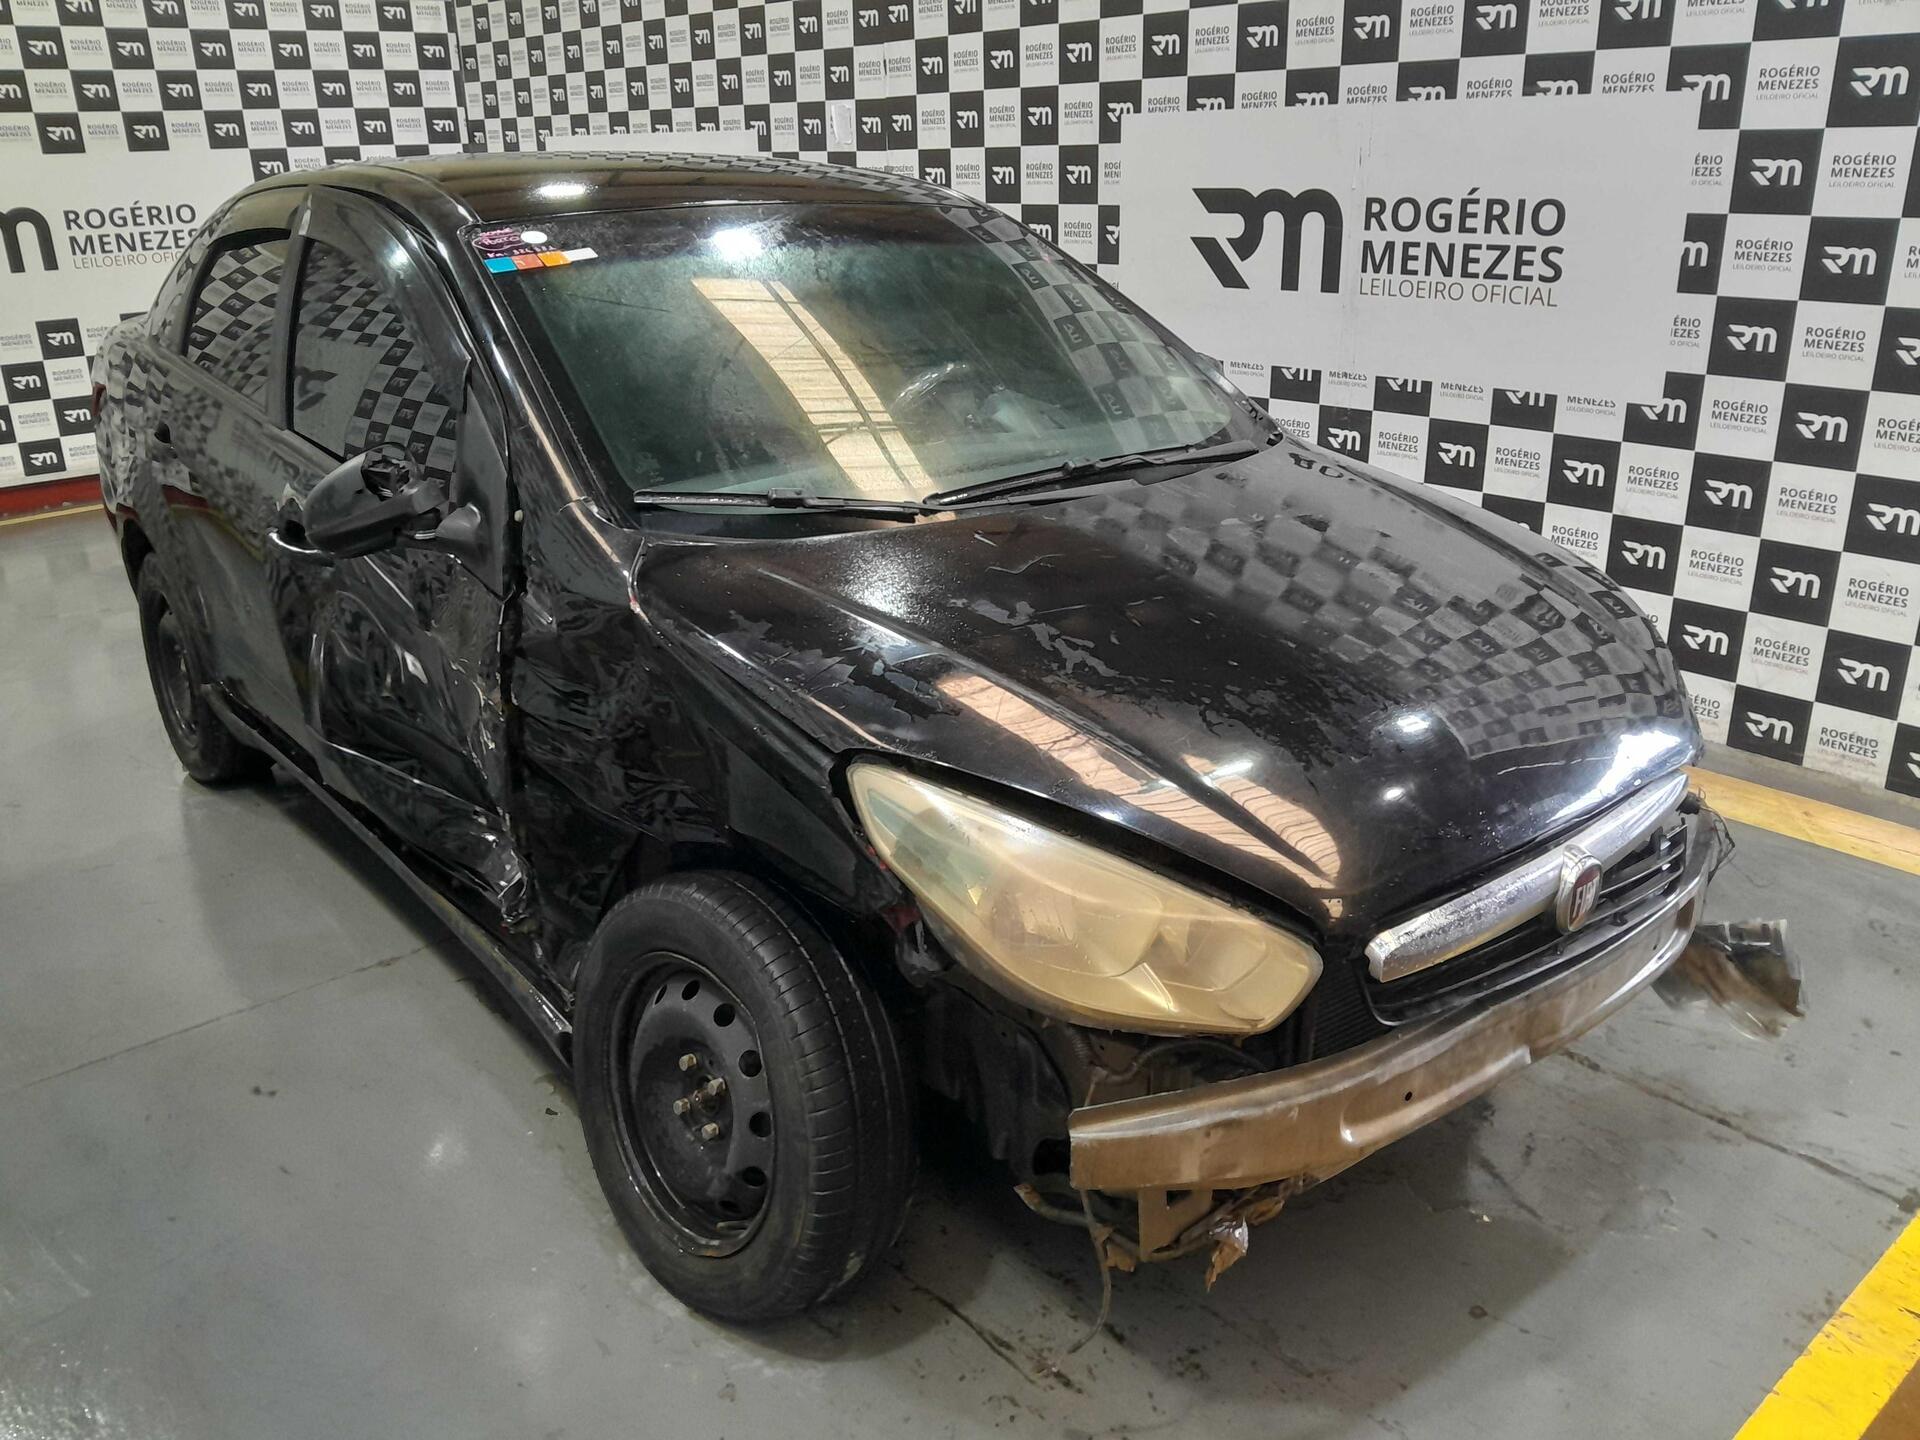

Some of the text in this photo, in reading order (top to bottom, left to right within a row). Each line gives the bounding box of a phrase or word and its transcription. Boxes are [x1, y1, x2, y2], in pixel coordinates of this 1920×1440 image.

[1410, 4, 1454, 17] ROGÉRIO
[1539, 5, 1589, 18] MENEZES
[1296, 15, 1335, 28] ROGÉRIO
[1409, 15, 1454, 28] MENEZES
[1195, 25, 1230, 37] ROGÉRIO
[1296, 26, 1334, 38] MENEZES
[1105, 34, 1136, 45] ROGÉRIO
[1195, 35, 1230, 46] MENEZES
[1025, 42, 1053, 52] ROGÉRIO
[1105, 44, 1136, 54] MENEZES
[953, 49, 978, 59] ROGÉRIO
[1025, 51, 1053, 61] MENEZES
[953, 58, 979, 67] MENEZES
[1603, 71, 1655, 84] ROGÉRIO
[1759, 64, 1820, 78] ROGÉRIO
[1347, 83, 1388, 96] ROGÉRIO
[1467, 77, 1513, 90] ROGÉRIO
[1757, 78, 1819, 91] MENEZES
[1241, 90, 1277, 101] ROGÉRIO
[989, 104, 1015, 114] ROGÉRIO
[1064, 100, 1093, 110] ROGÉRIO
[921, 108, 945, 117] ROGÉRIO
[989, 114, 1015, 122] MENEZES
[1064, 110, 1093, 119] MENEZES
[921, 117, 946, 125] MENEZES
[1694, 152, 1723, 165] ÉRIO
[1832, 152, 1897, 165] ROGÉRIO
[955, 162, 980, 171] ROGÉRIO
[1026, 161, 1053, 171] ROGÉRIO
[1830, 167, 1895, 178] MENEZES
[1026, 171, 1053, 179] MENEZES
[63, 200, 196, 230] ROGÉRIO
[1363, 188, 1566, 236] ROGÉRIO
[1064, 220, 1092, 230] ROGÉRIO
[1064, 230, 1092, 238] MENEZES
[1735, 238, 1793, 251] ROGÉRIO
[73, 252, 147, 270] LEILOEIRO
[1361, 240, 1564, 283] MENEZES
[1734, 250, 1792, 263] MENEZES
[1360, 278, 1558, 307] LEILOEIRO OFICIAL
[1673, 315, 1701, 328] ÉRIO
[1806, 326, 1866, 341] ROGÉRIO
[1804, 338, 1865, 353] MENEZES
[1713, 399, 1768, 414] ROGÉRIO
[1711, 410, 1767, 425] MENEZES
[1379, 431, 1419, 444] ROGÉRIO
[1378, 440, 1418, 453] MENEZES
[1496, 446, 1541, 461] ROGÉRIO
[1495, 456, 1540, 471] MENEZES
[1628, 465, 1680, 481] ROGÉRIO
[1627, 475, 1678, 491] MENEZES
[1780, 486, 1838, 504] ROGÉRIO
[1778, 497, 1837, 515] MENEZES
[1552, 525, 1599, 540] ROGÉRIO
[1550, 534, 1598, 550] MENEZES
[1690, 549, 1744, 567] ROGÉRIO
[1689, 559, 1743, 577] MENEZES
[1849, 577, 1909, 598] ROGÉRIO
[1847, 588, 1908, 609] MENEZES
[1755, 636, 1811, 656] ROGÉRIO
[1753, 646, 1809, 667] MENEZES
[1821, 727, 1879, 748] ROGÉRIO
[1819, 737, 1879, 759] MENEZES
